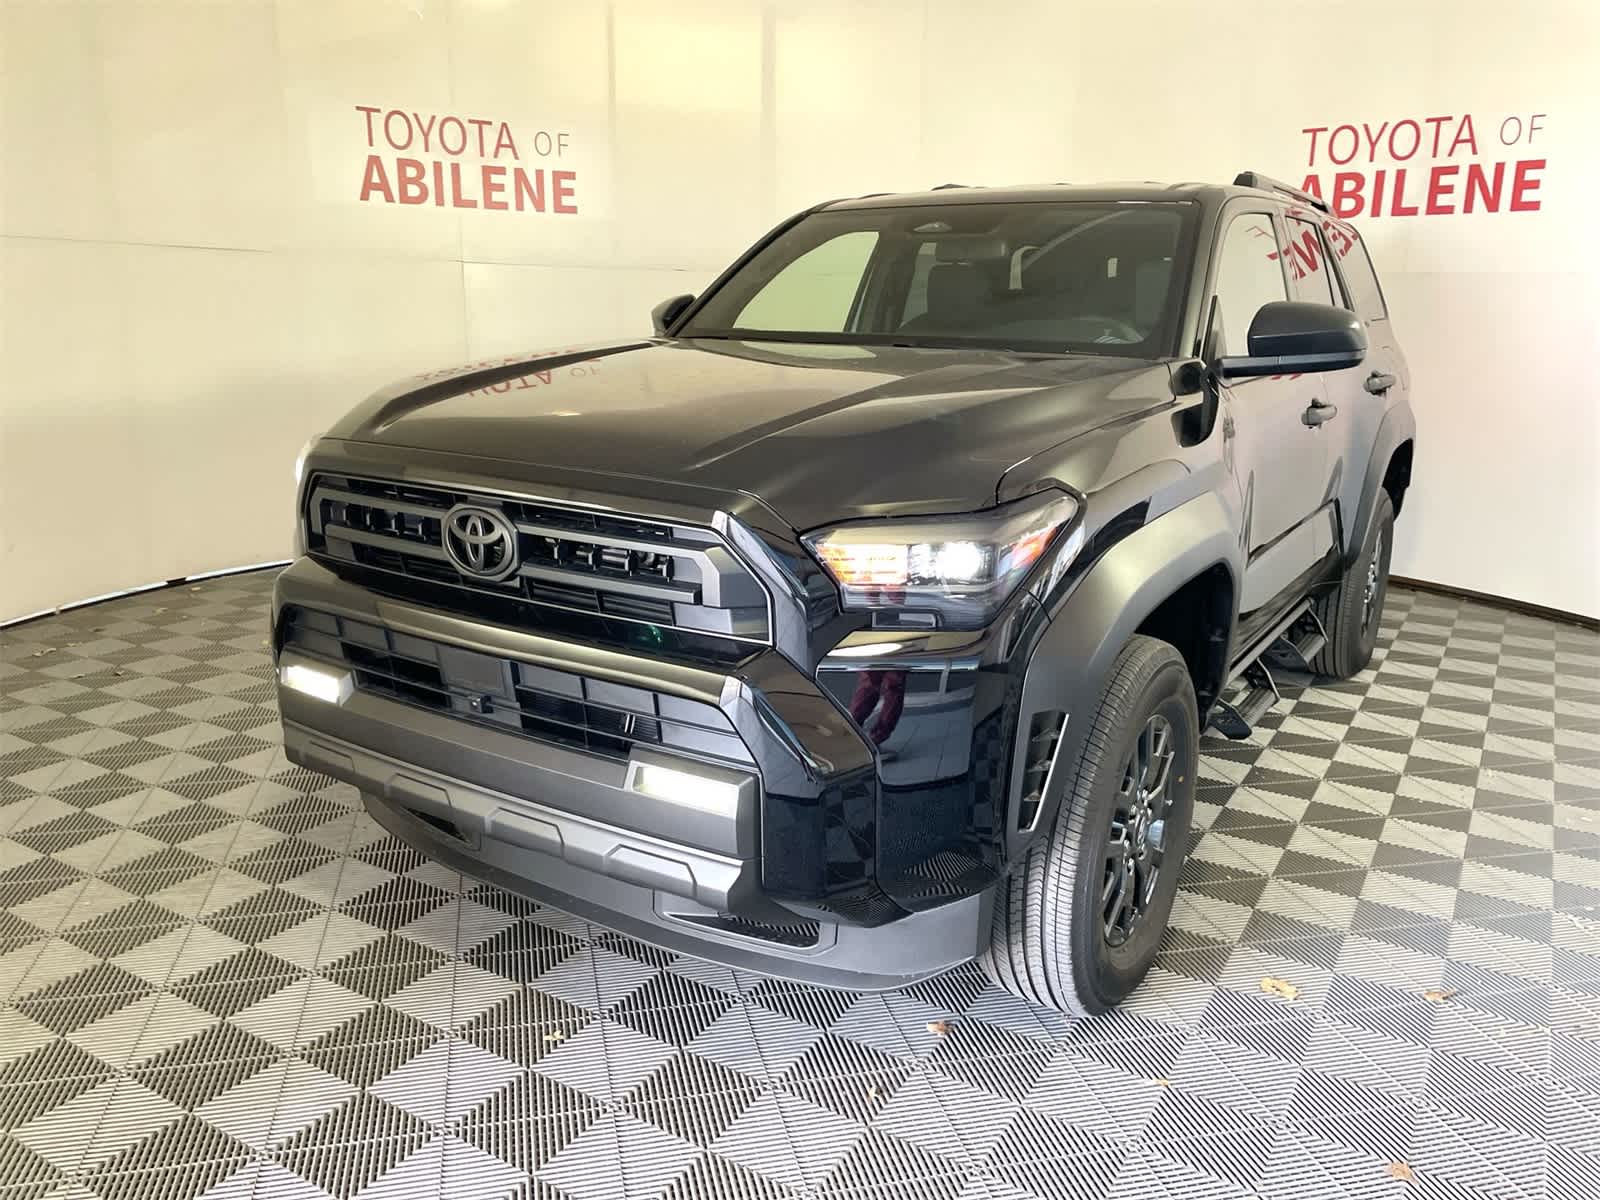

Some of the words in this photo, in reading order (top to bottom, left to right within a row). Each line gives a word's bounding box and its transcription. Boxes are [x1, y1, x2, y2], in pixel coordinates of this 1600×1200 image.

[355, 105, 519, 160] TOYOTA
[534, 131, 570, 157] OF
[1302, 114, 1478, 167] TOYOTA
[1499, 114, 1547, 146] OF
[359, 154, 578, 214] ABILENE
